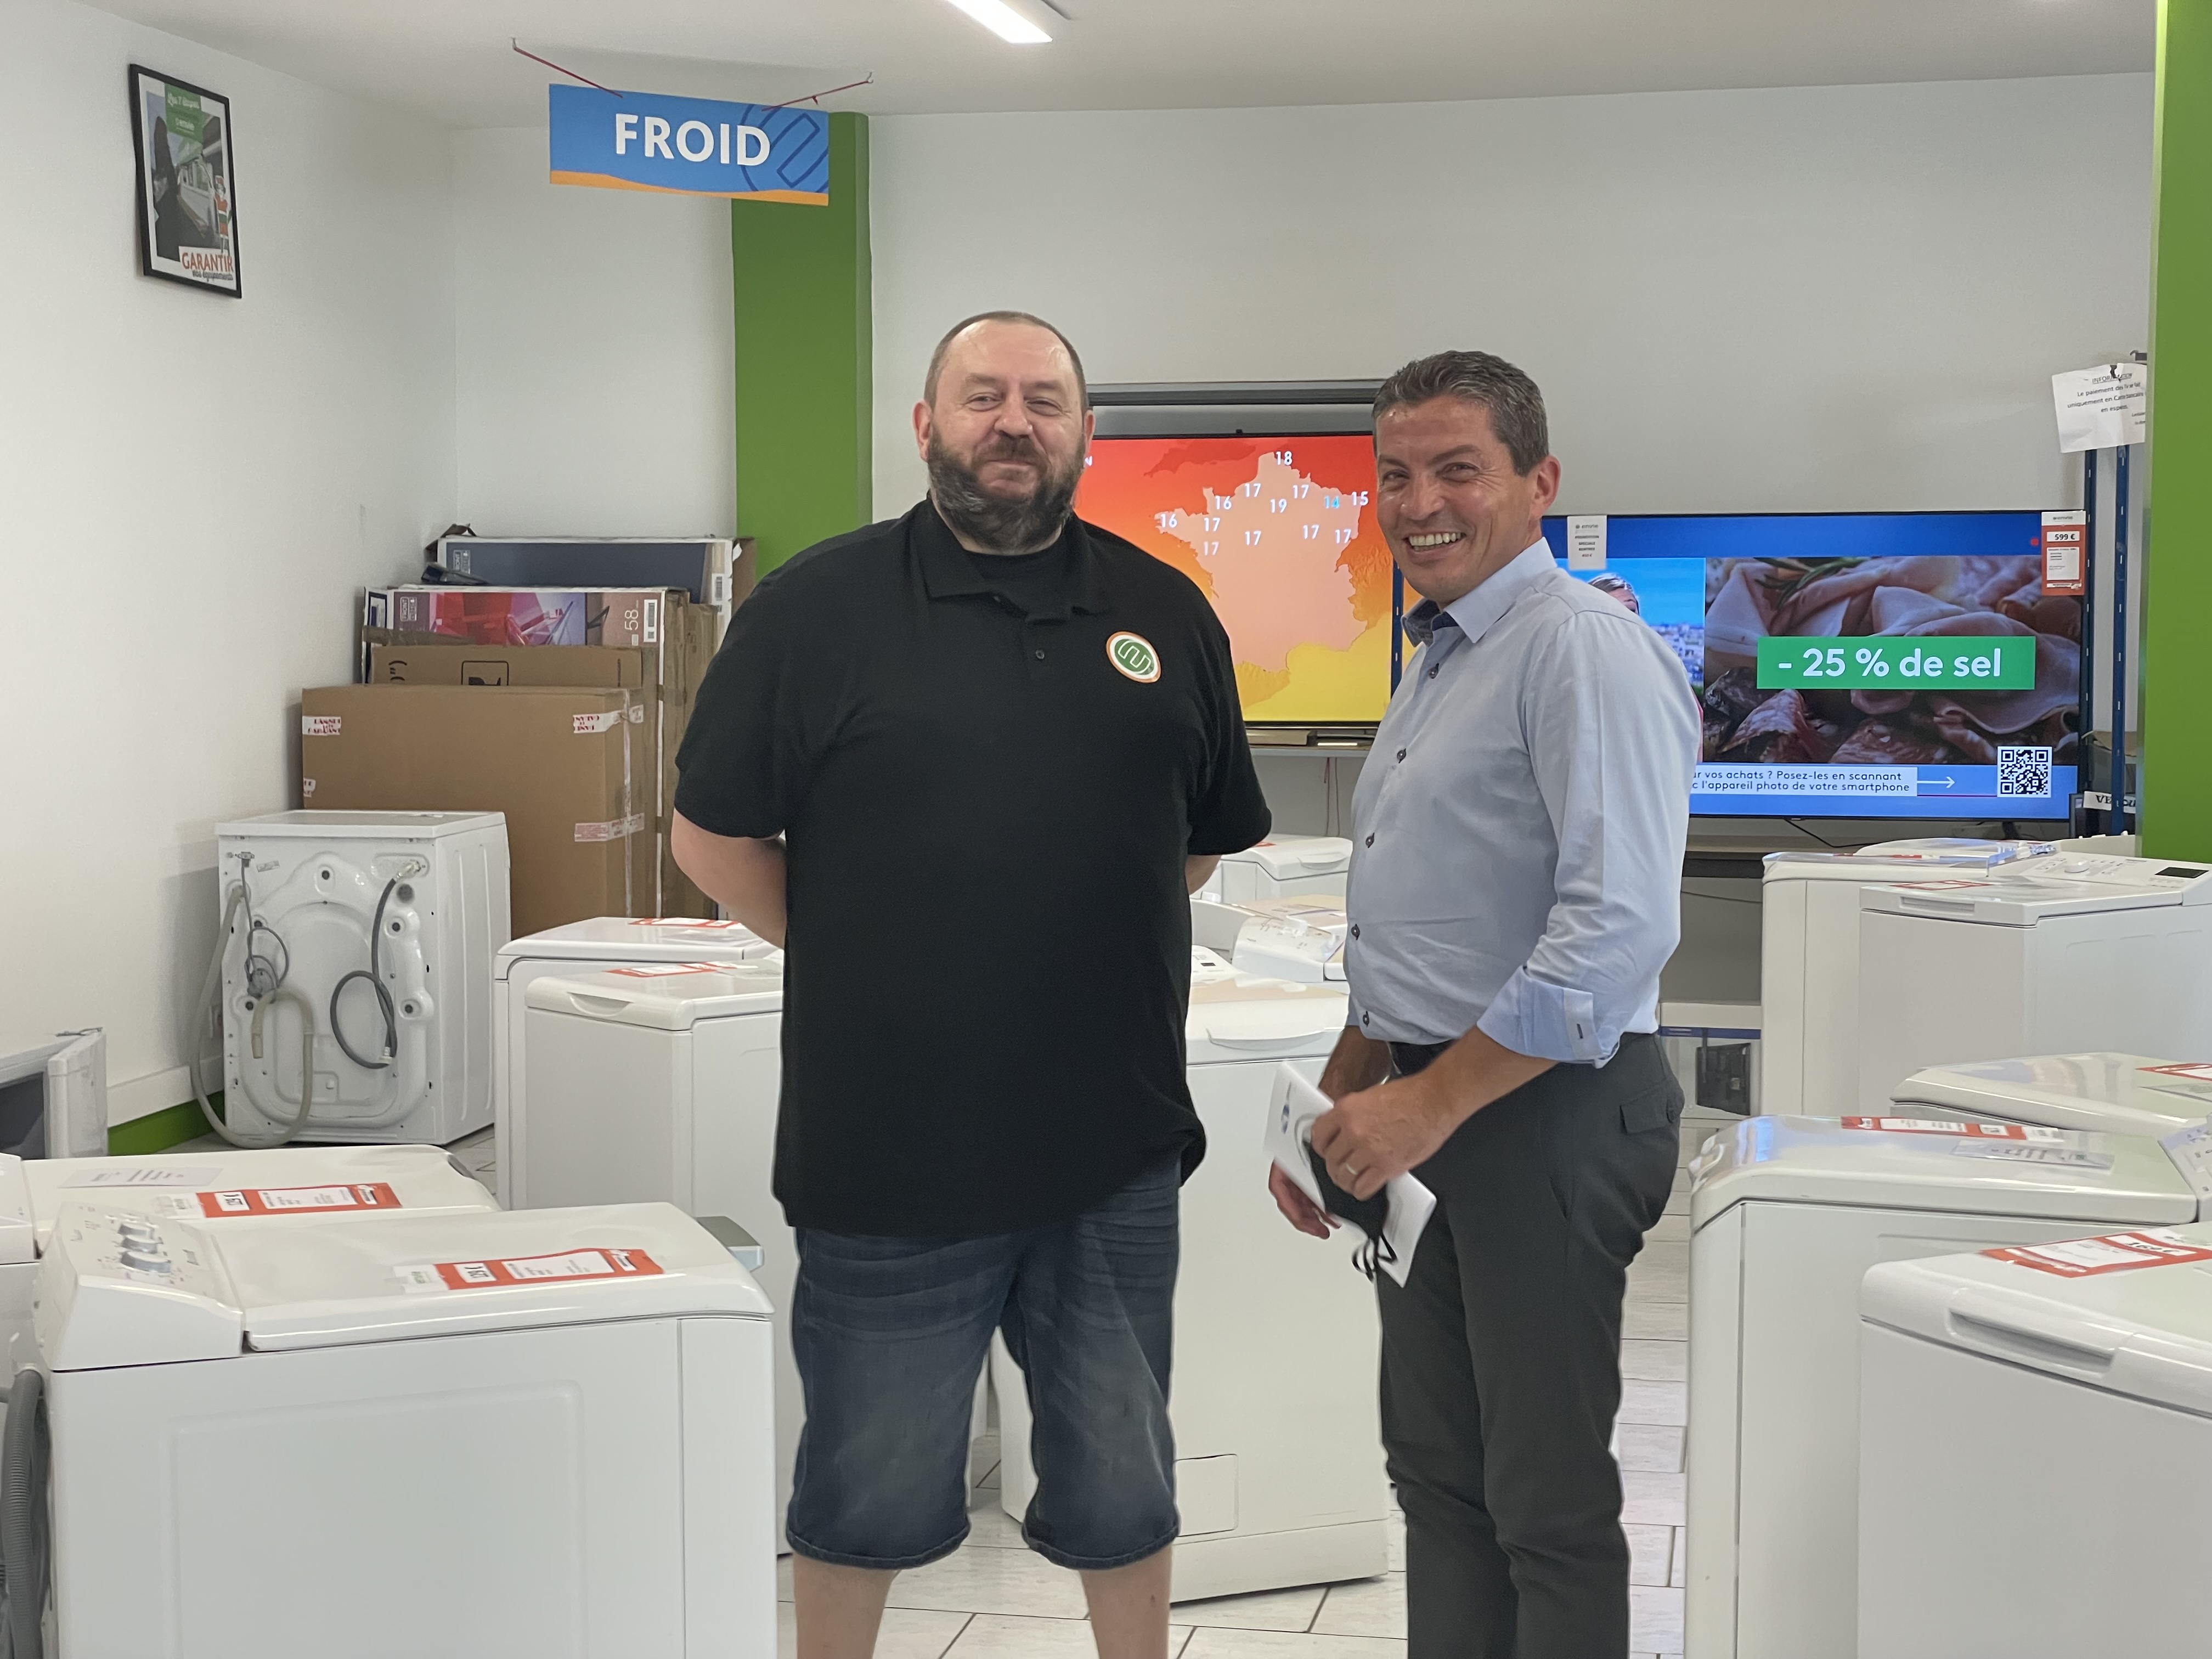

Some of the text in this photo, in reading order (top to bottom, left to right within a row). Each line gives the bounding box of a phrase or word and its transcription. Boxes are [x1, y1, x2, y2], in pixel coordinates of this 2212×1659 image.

[616, 113, 770, 166] FROID
[182, 252, 234, 272] GARANTIR
[2086, 387, 2114, 396] paiement
[2067, 398, 2103, 408] uniquement
[1276, 451, 1293, 465] 18
[1244, 483, 1261, 498] 17
[1293, 484, 1310, 499] 17
[1215, 495, 1232, 510] 16
[1270, 498, 1287, 514] 19
[1324, 495, 1340, 509] 14
[1351, 491, 1368, 506] 15
[1160, 513, 1178, 528] 16
[1204, 517, 1221, 532] 17
[1245, 530, 1262, 546] 17
[1302, 524, 1319, 540] 17
[1335, 528, 1352, 544] 17
[1204, 541, 1220, 556] 17
[624, 610, 639, 630] 58
[1803, 648, 1846, 676] 25
[1855, 648, 1889, 677] %
[1899, 648, 1943, 677] de
[1953, 648, 2001, 677] sel
[1726, 770, 1764, 779] achats
[1768, 771, 1773, 779] ?
[1776, 771, 1829, 780] Posez-les
[1702, 780, 1753, 791] l'appareil
[1757, 781, 1788, 791] photo
[1792, 781, 1805, 790] de
[1842, 783, 1910, 793] smartphone
